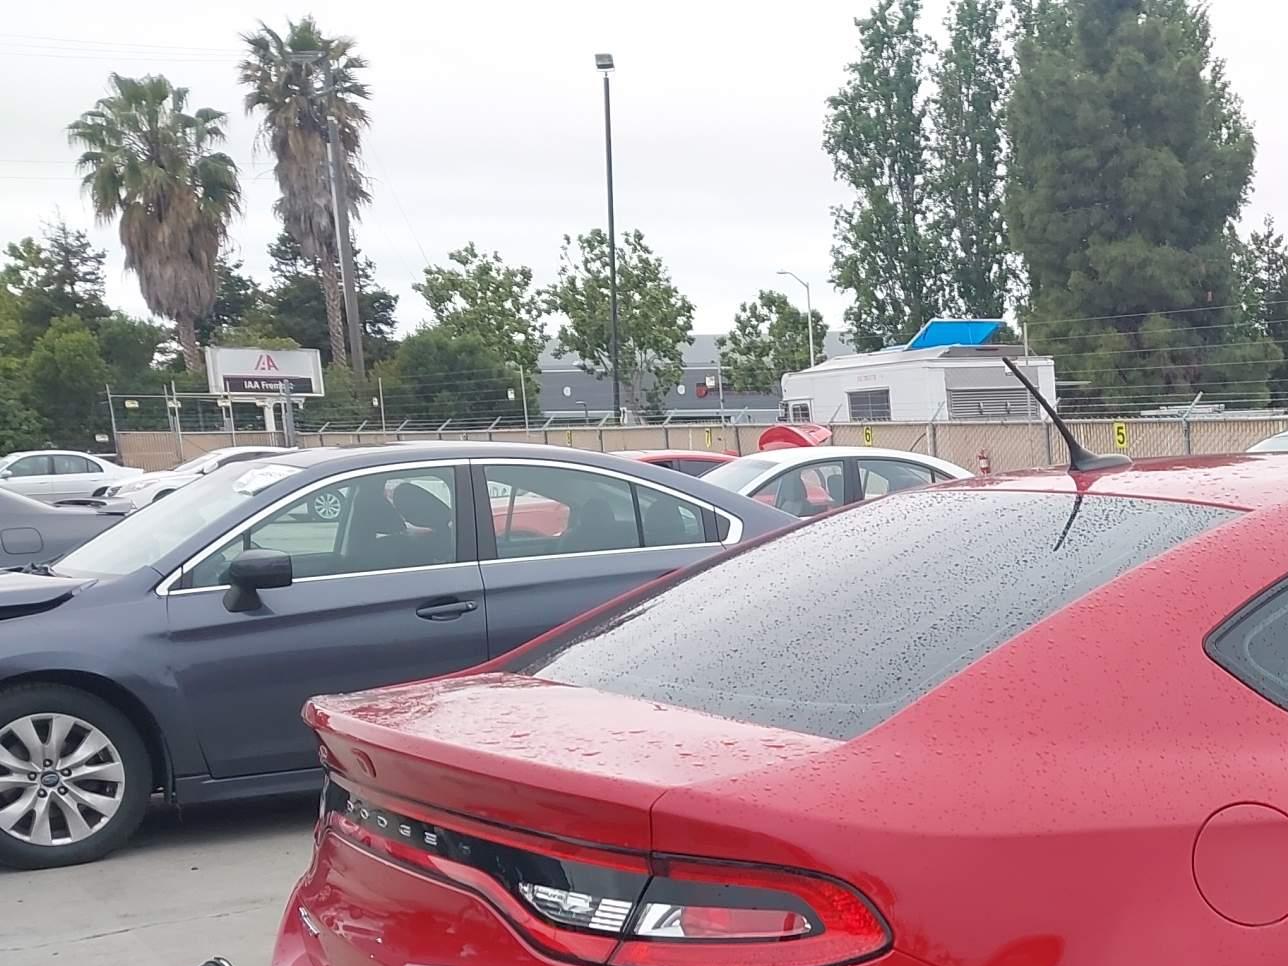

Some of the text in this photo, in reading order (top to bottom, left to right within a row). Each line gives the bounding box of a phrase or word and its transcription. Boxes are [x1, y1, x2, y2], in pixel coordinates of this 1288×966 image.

[244, 380, 260, 389] IAA
[1116, 426, 1125, 445] 5
[346, 800, 438, 846] DODGE
